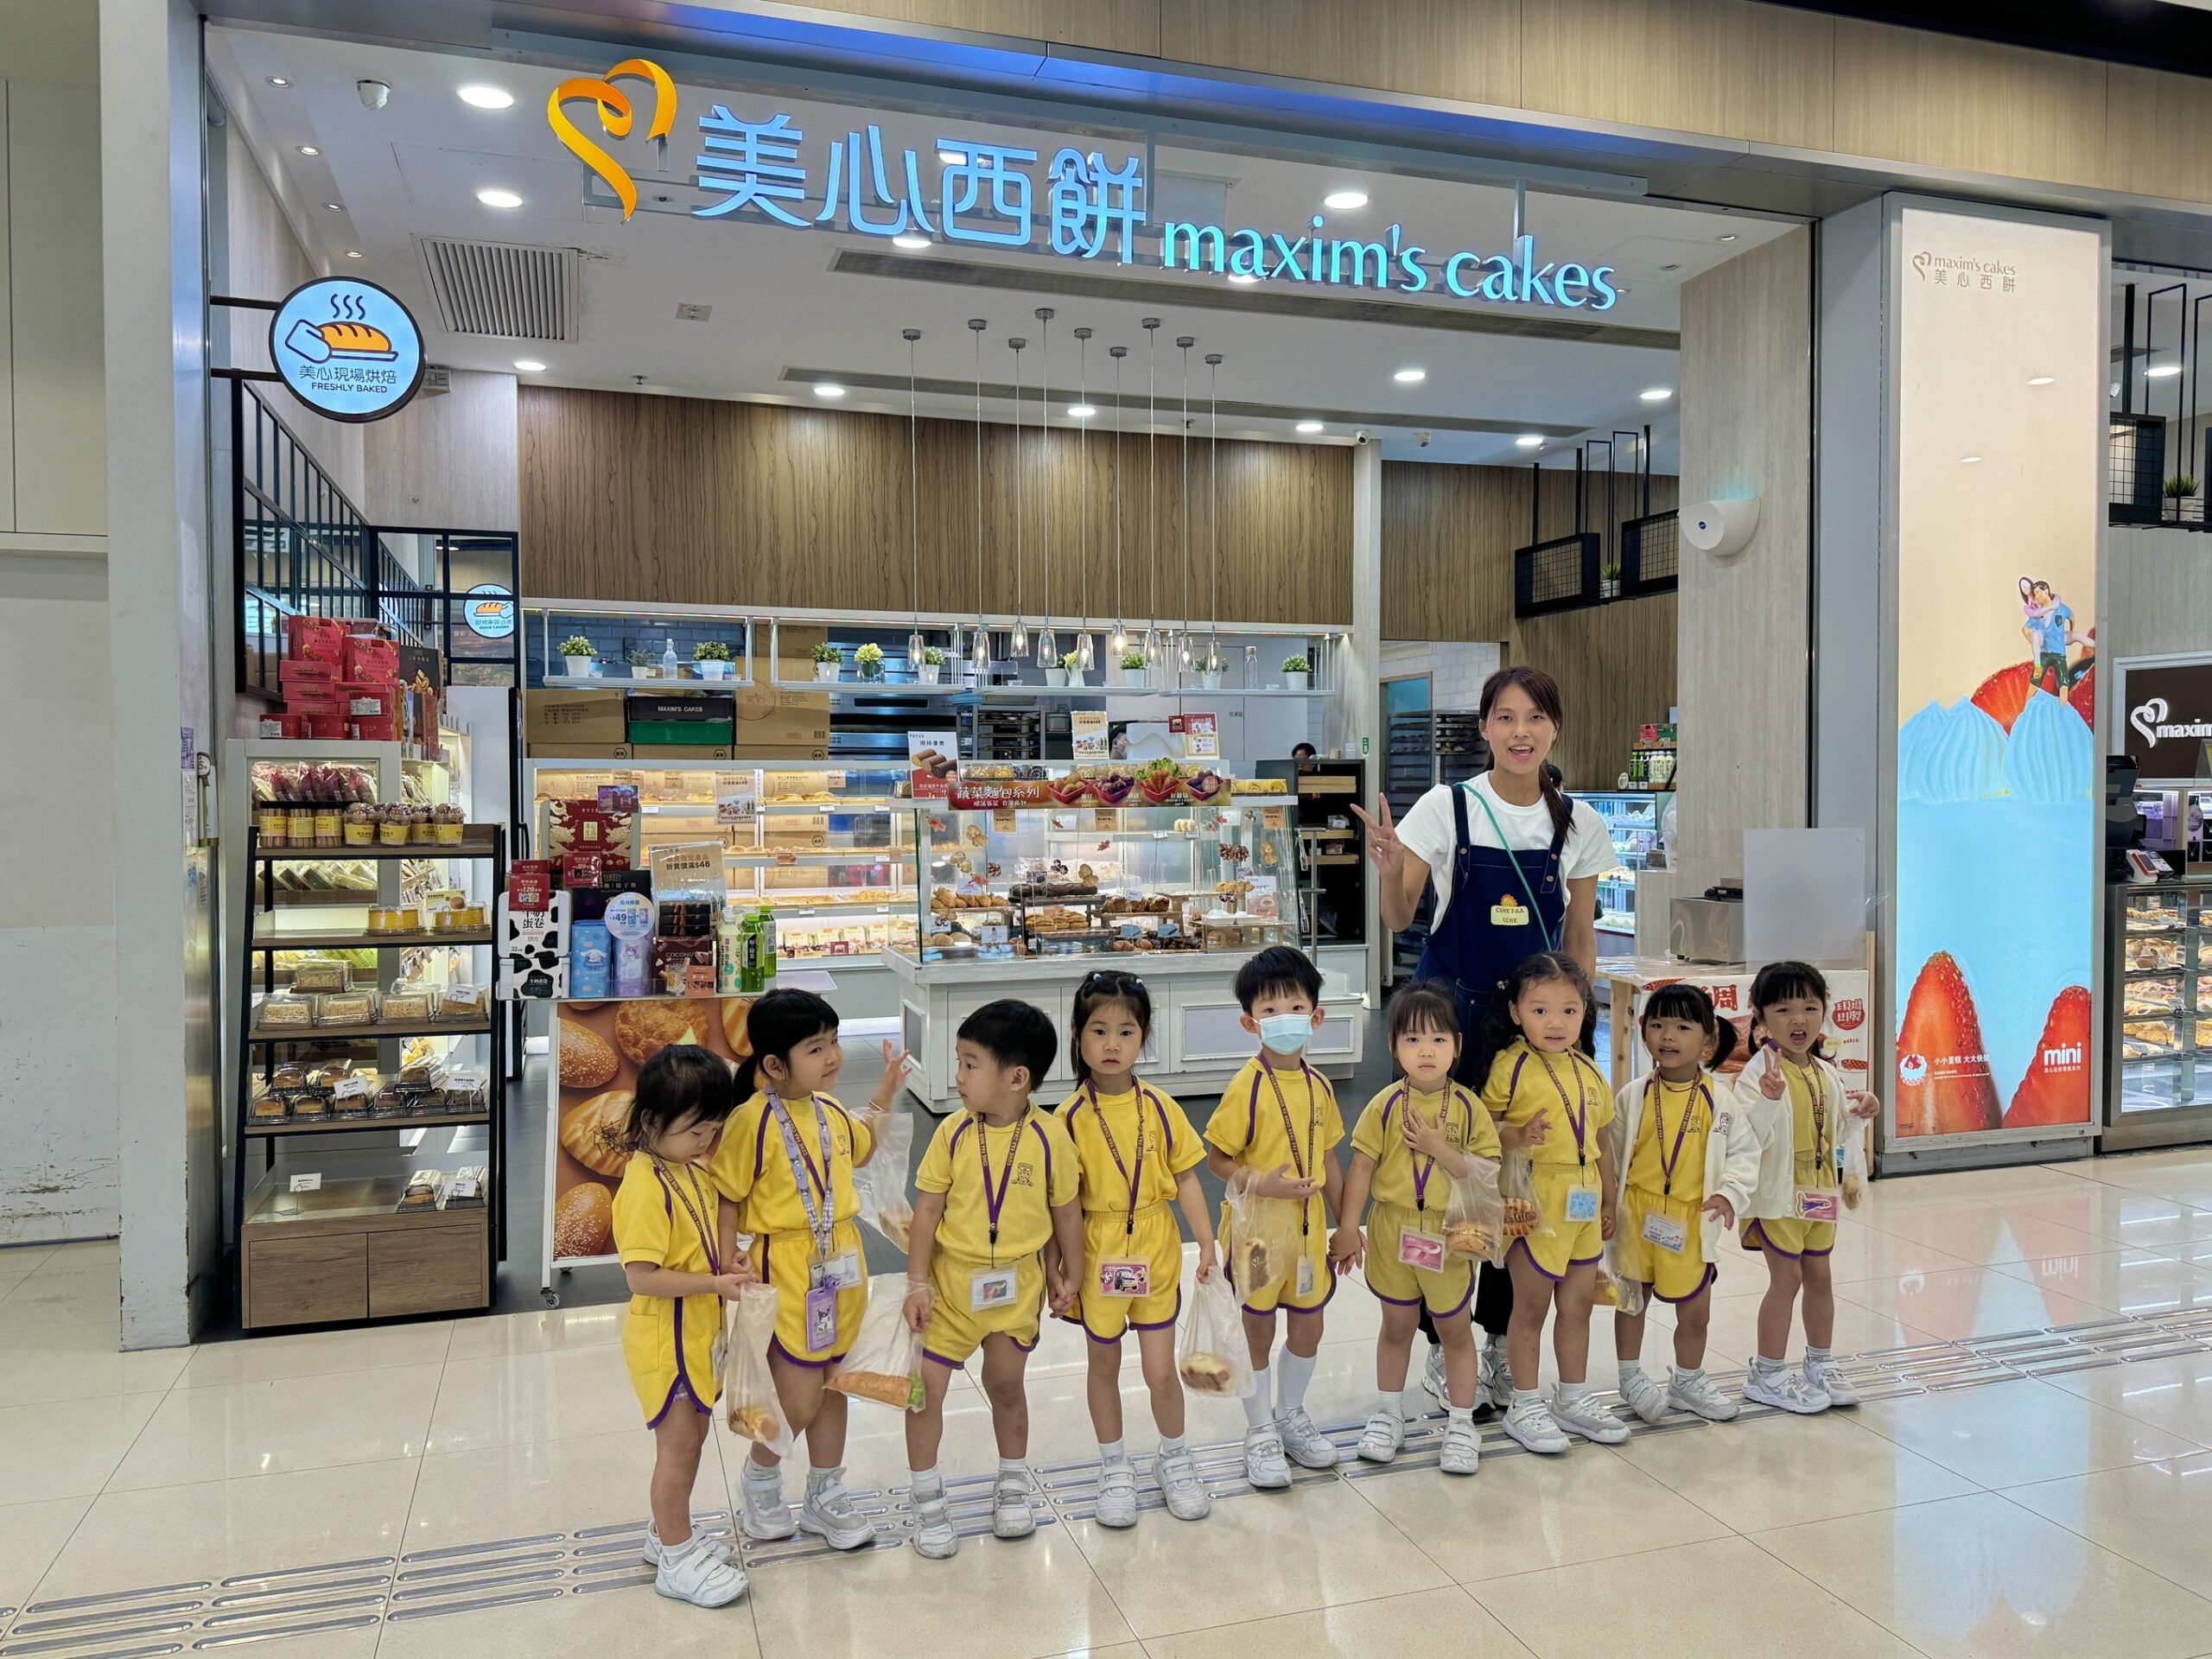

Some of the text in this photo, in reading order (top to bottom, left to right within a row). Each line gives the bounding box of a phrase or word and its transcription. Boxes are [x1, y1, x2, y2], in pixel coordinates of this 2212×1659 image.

[691, 105, 1147, 264] 美心西餅
[1163, 214, 1617, 310] maxim's cakes
[1935, 256, 2016, 276] maxim's cakes
[1935, 269, 2016, 293] 美心西餅
[299, 365, 397, 385] 美心現場烘焙
[312, 382, 387, 393] FRESHLY BAKED
[957, 785, 1039, 800] 蔬菜麵包系列
[1934, 1056, 1961, 1065] 小小蛋糕
[2044, 1042, 2082, 1066] mini
